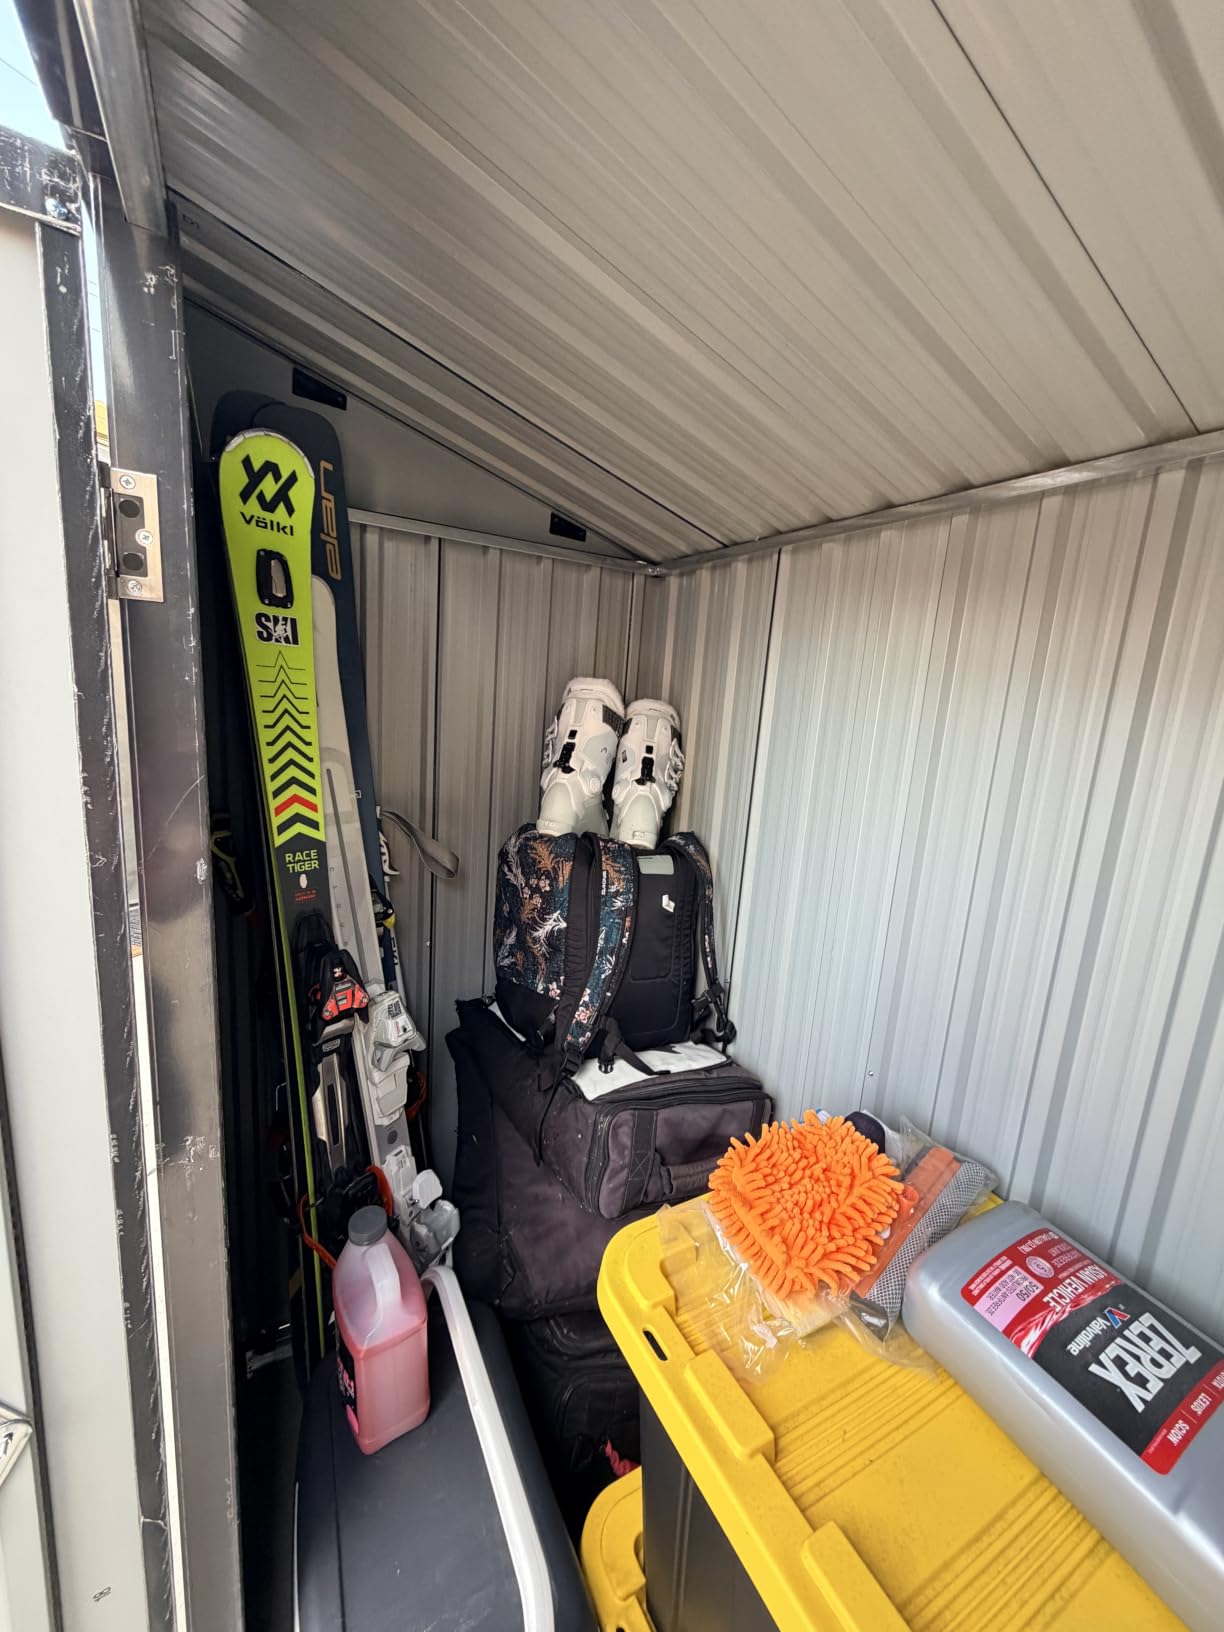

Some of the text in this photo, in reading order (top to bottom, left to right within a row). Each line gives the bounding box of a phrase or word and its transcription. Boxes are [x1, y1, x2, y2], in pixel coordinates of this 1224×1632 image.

[240, 511, 294, 536] Völkl
[320, 460, 342, 581] elan
[255, 613, 300, 645] SKI
[285, 850, 318, 863] RACE
[287, 860, 320, 873] TIGER
[1076, 1264, 1108, 1285] ASIAN
[986, 1292, 1009, 1316] ANTIFREEZE
[1016, 1281, 1039, 1302] 50/50
[1043, 1276, 1088, 1312] VEHICLE
[1067, 1317, 1111, 1356] Valvoline
[1088, 1312, 1202, 1414] ZEREX
[1191, 1393, 1212, 1416] LEXUS
[1167, 1419, 1190, 1446] SCION
